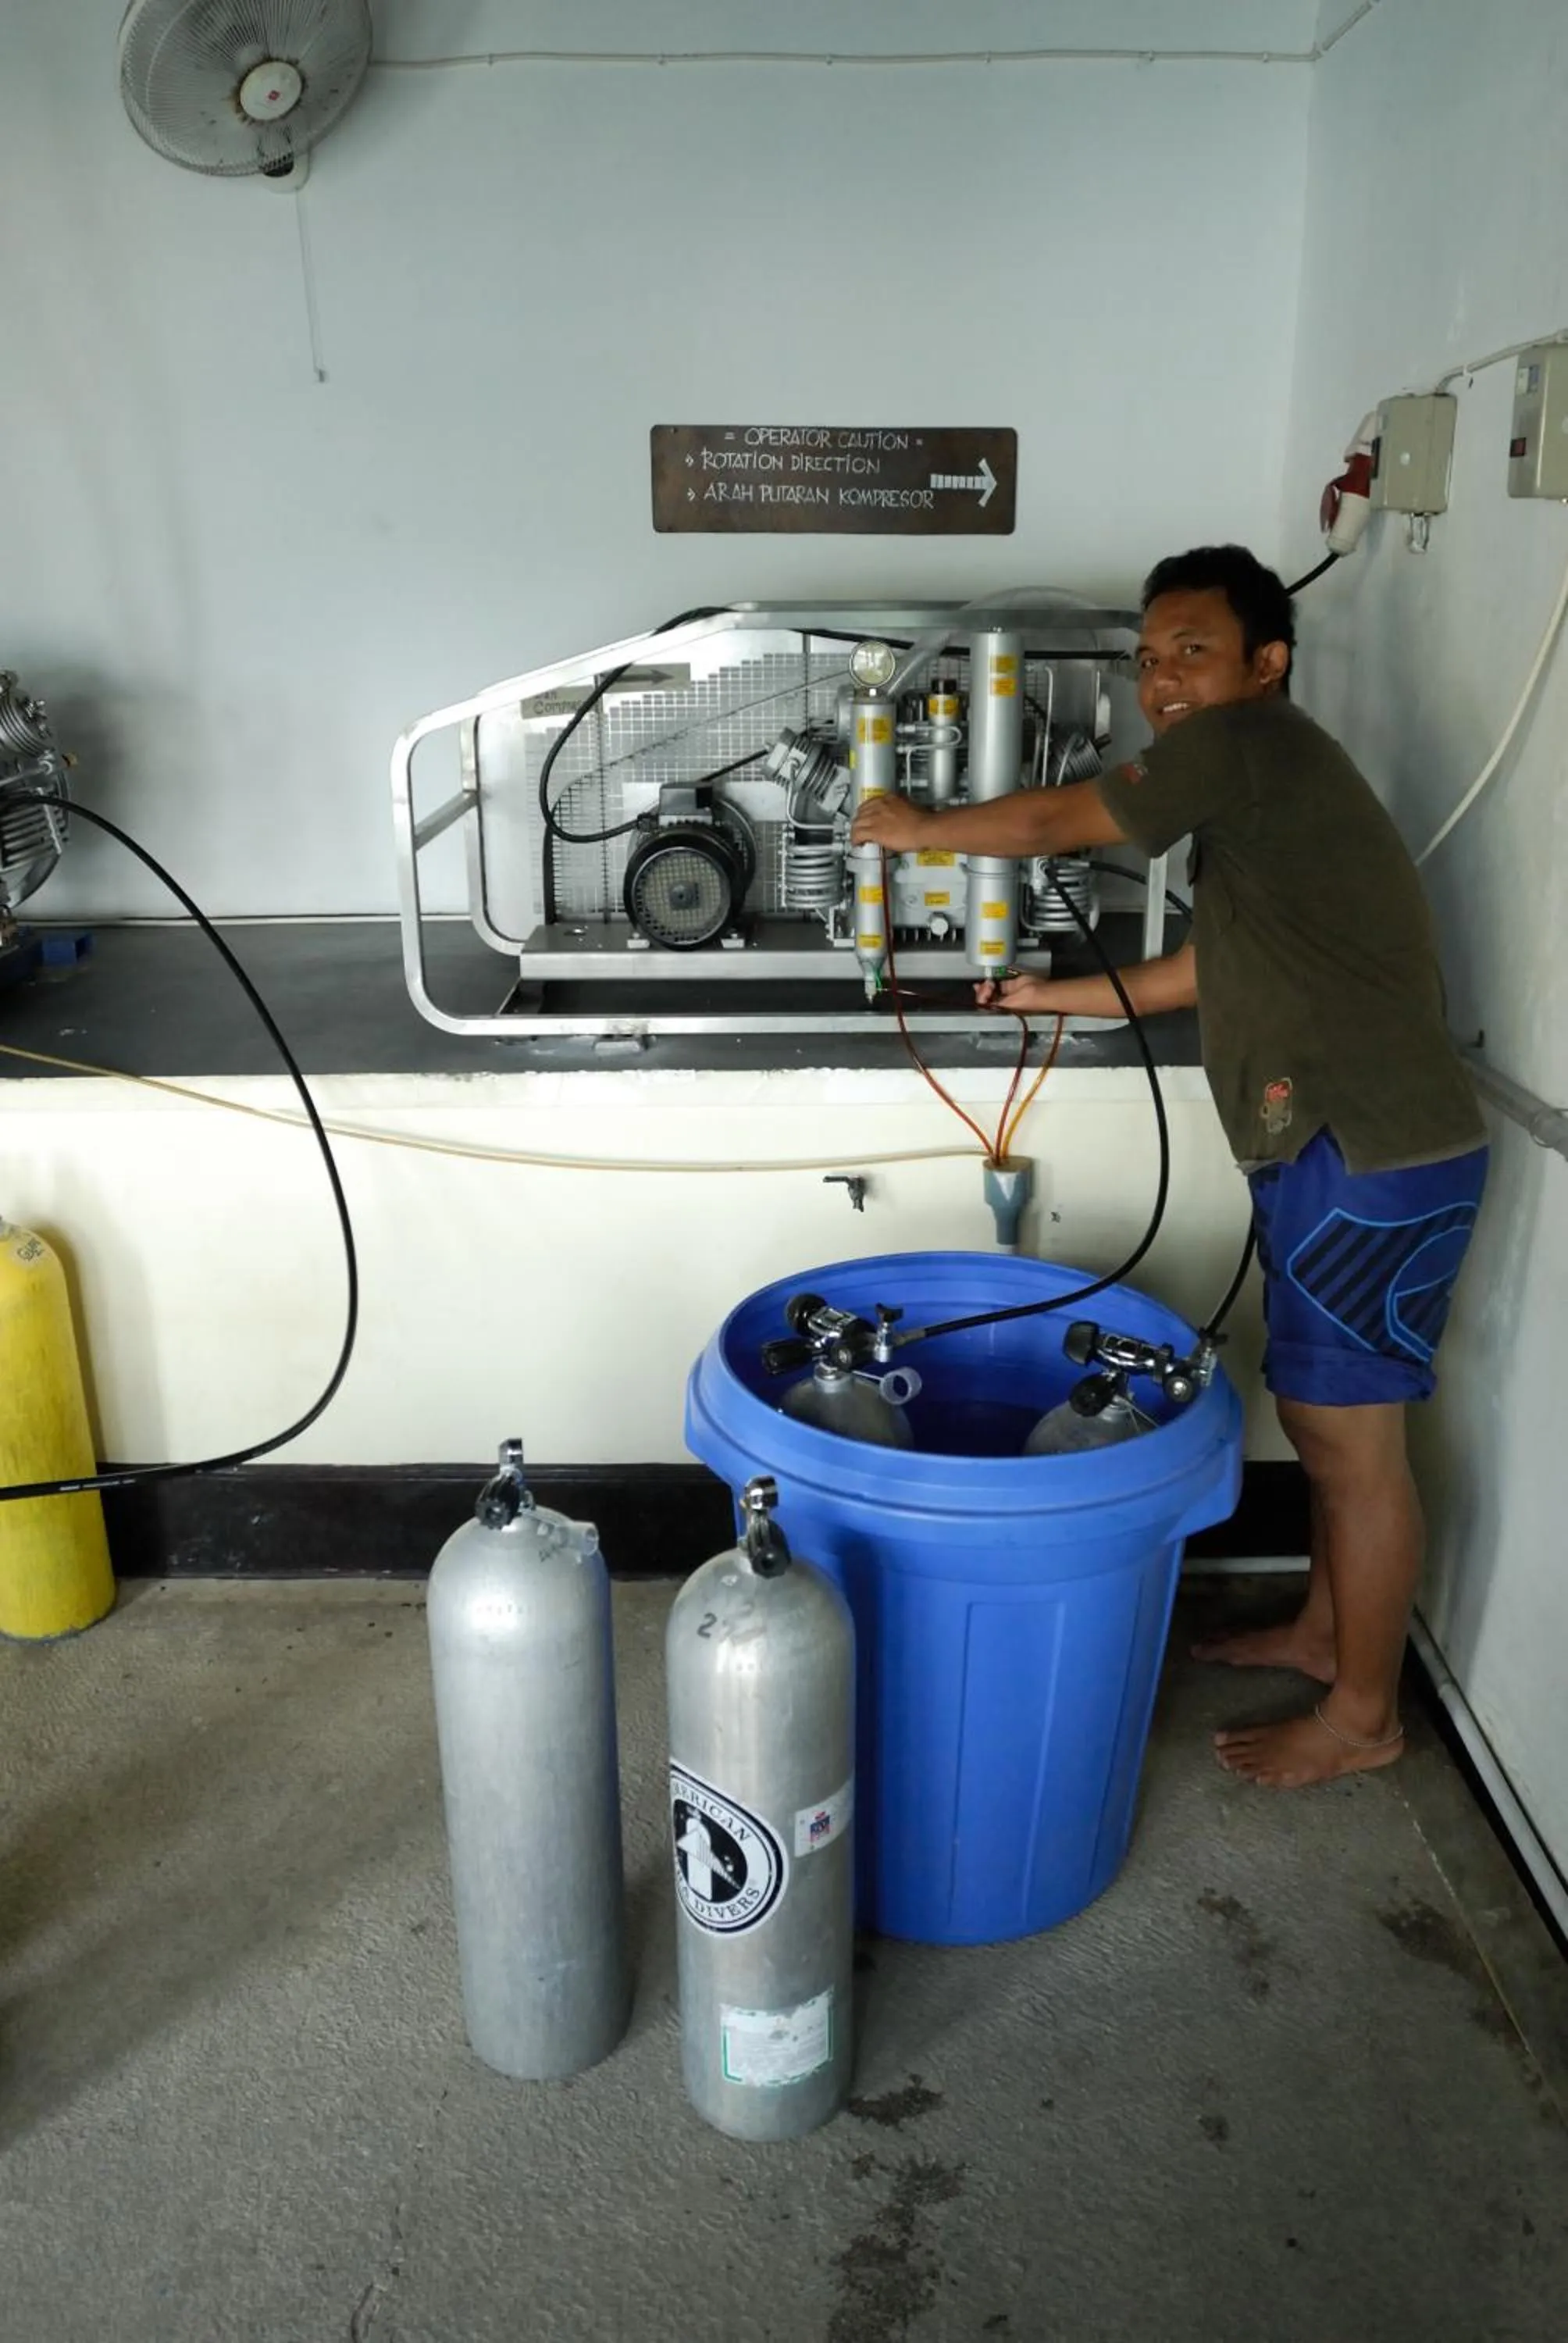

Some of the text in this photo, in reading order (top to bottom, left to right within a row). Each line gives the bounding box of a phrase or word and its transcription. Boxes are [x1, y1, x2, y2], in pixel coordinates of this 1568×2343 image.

[744, 427, 910, 451] OPERATOR CAUTION
[700, 447, 881, 475] ROTATION DIRECTION
[703, 482, 935, 509] ARAH PUTARAN KOMPRESOR
[694, 1887, 761, 1919] DIVERS
